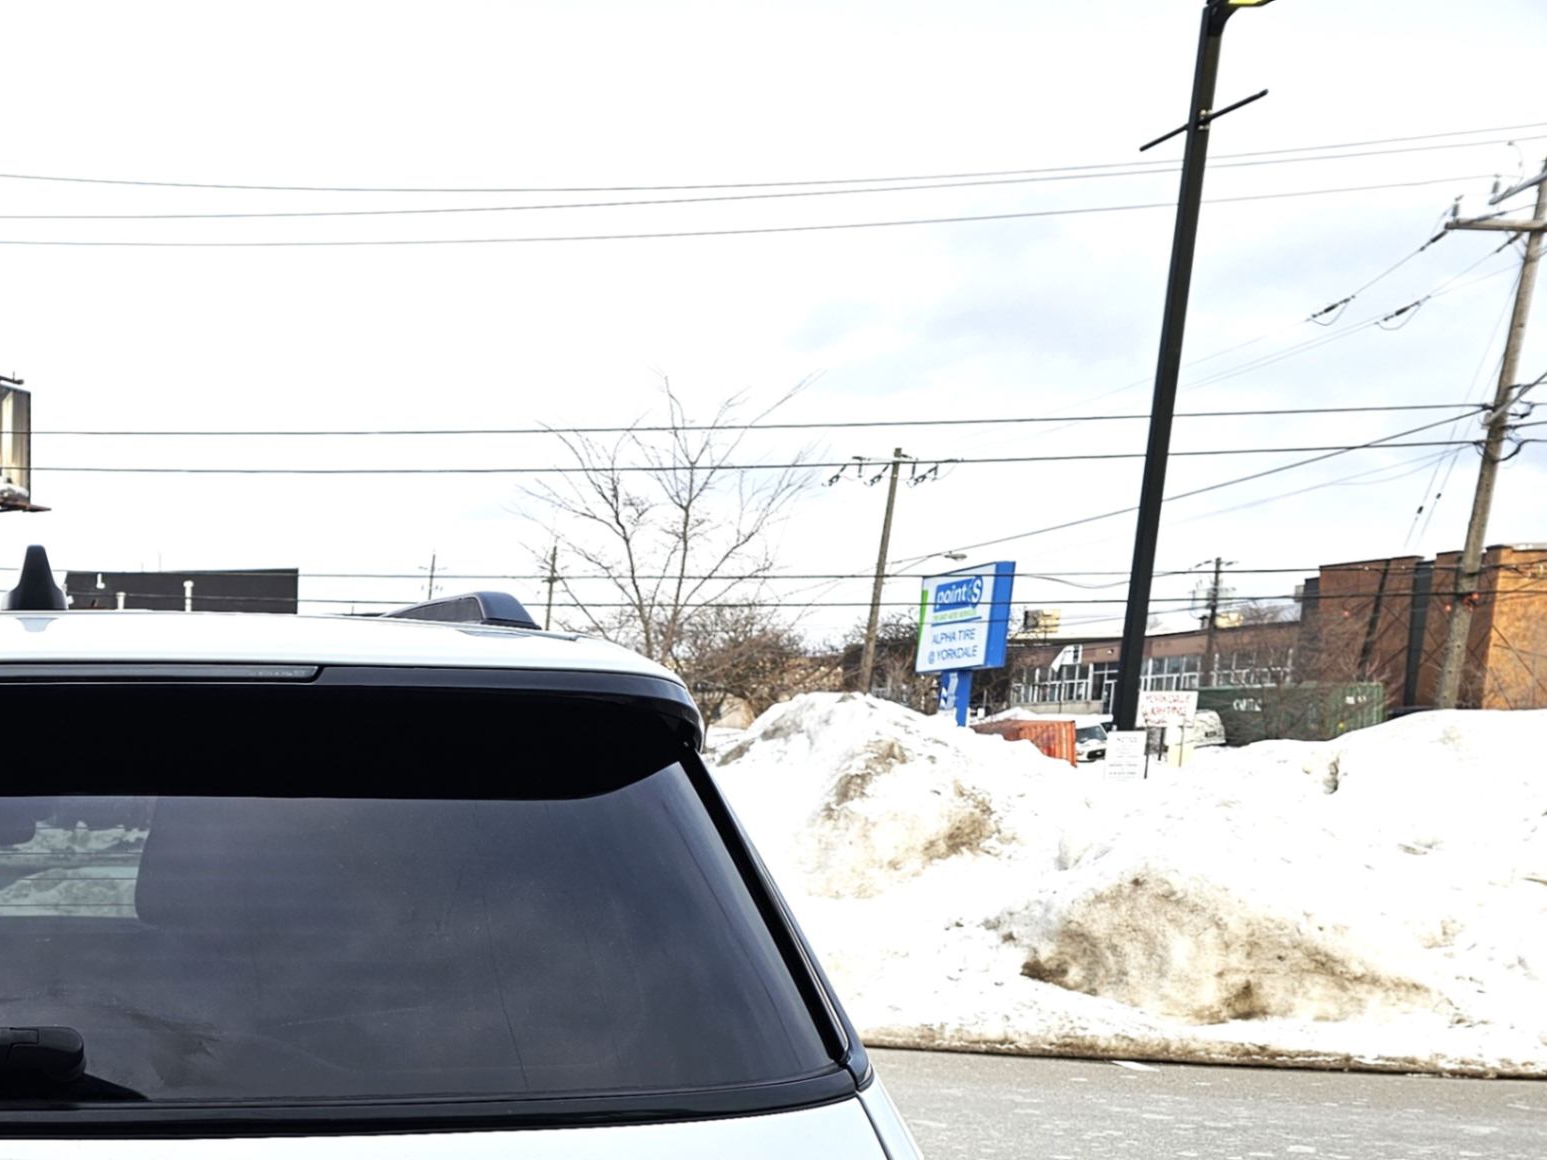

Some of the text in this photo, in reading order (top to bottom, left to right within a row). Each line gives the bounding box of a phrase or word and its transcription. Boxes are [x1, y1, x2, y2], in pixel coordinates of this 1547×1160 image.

[936, 583, 967, 610] point
[932, 627, 976, 644] ALPHA TIRE
[937, 645, 978, 661] YORKDALE
